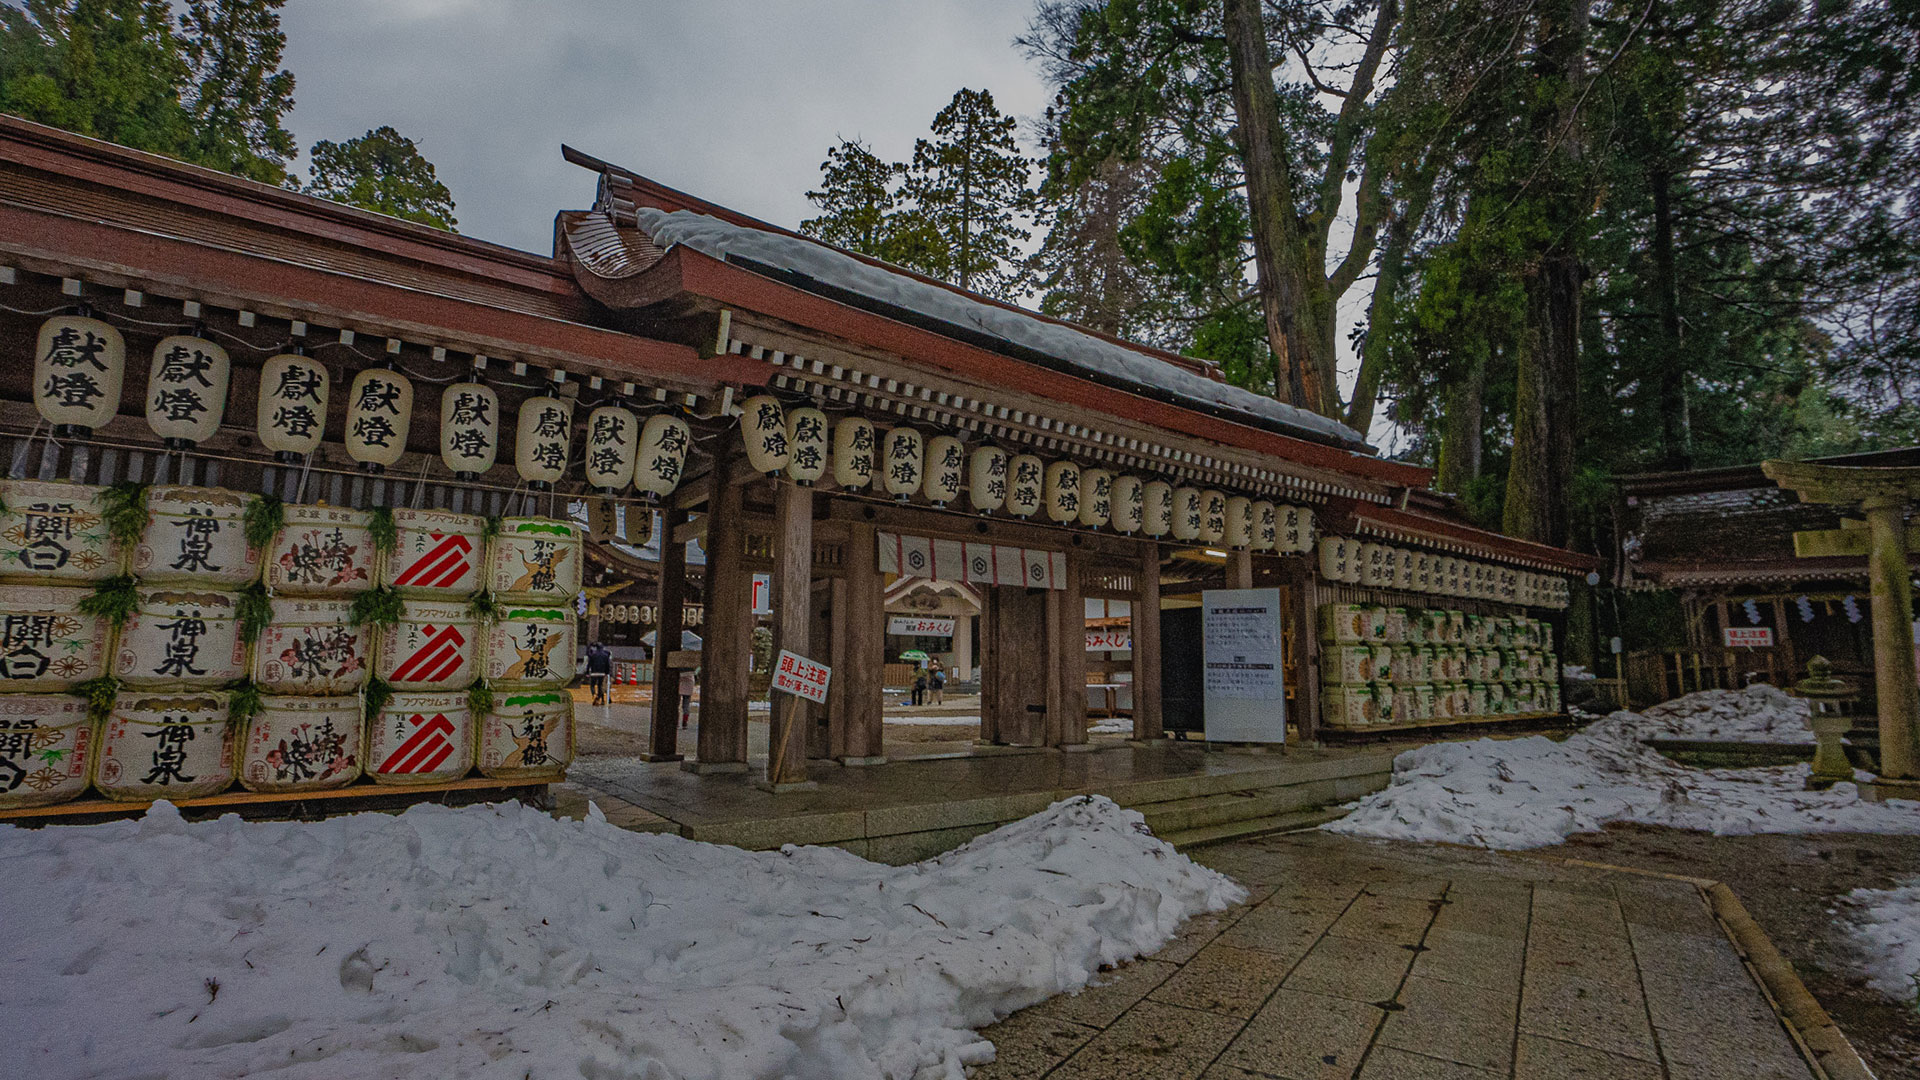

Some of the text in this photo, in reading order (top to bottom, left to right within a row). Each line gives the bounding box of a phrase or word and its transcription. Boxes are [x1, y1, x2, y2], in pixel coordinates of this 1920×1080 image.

[917, 621, 952, 633] おみくじ
[780, 655, 828, 685] 頭上注意
[778, 674, 823, 700] 雪が落ちます
